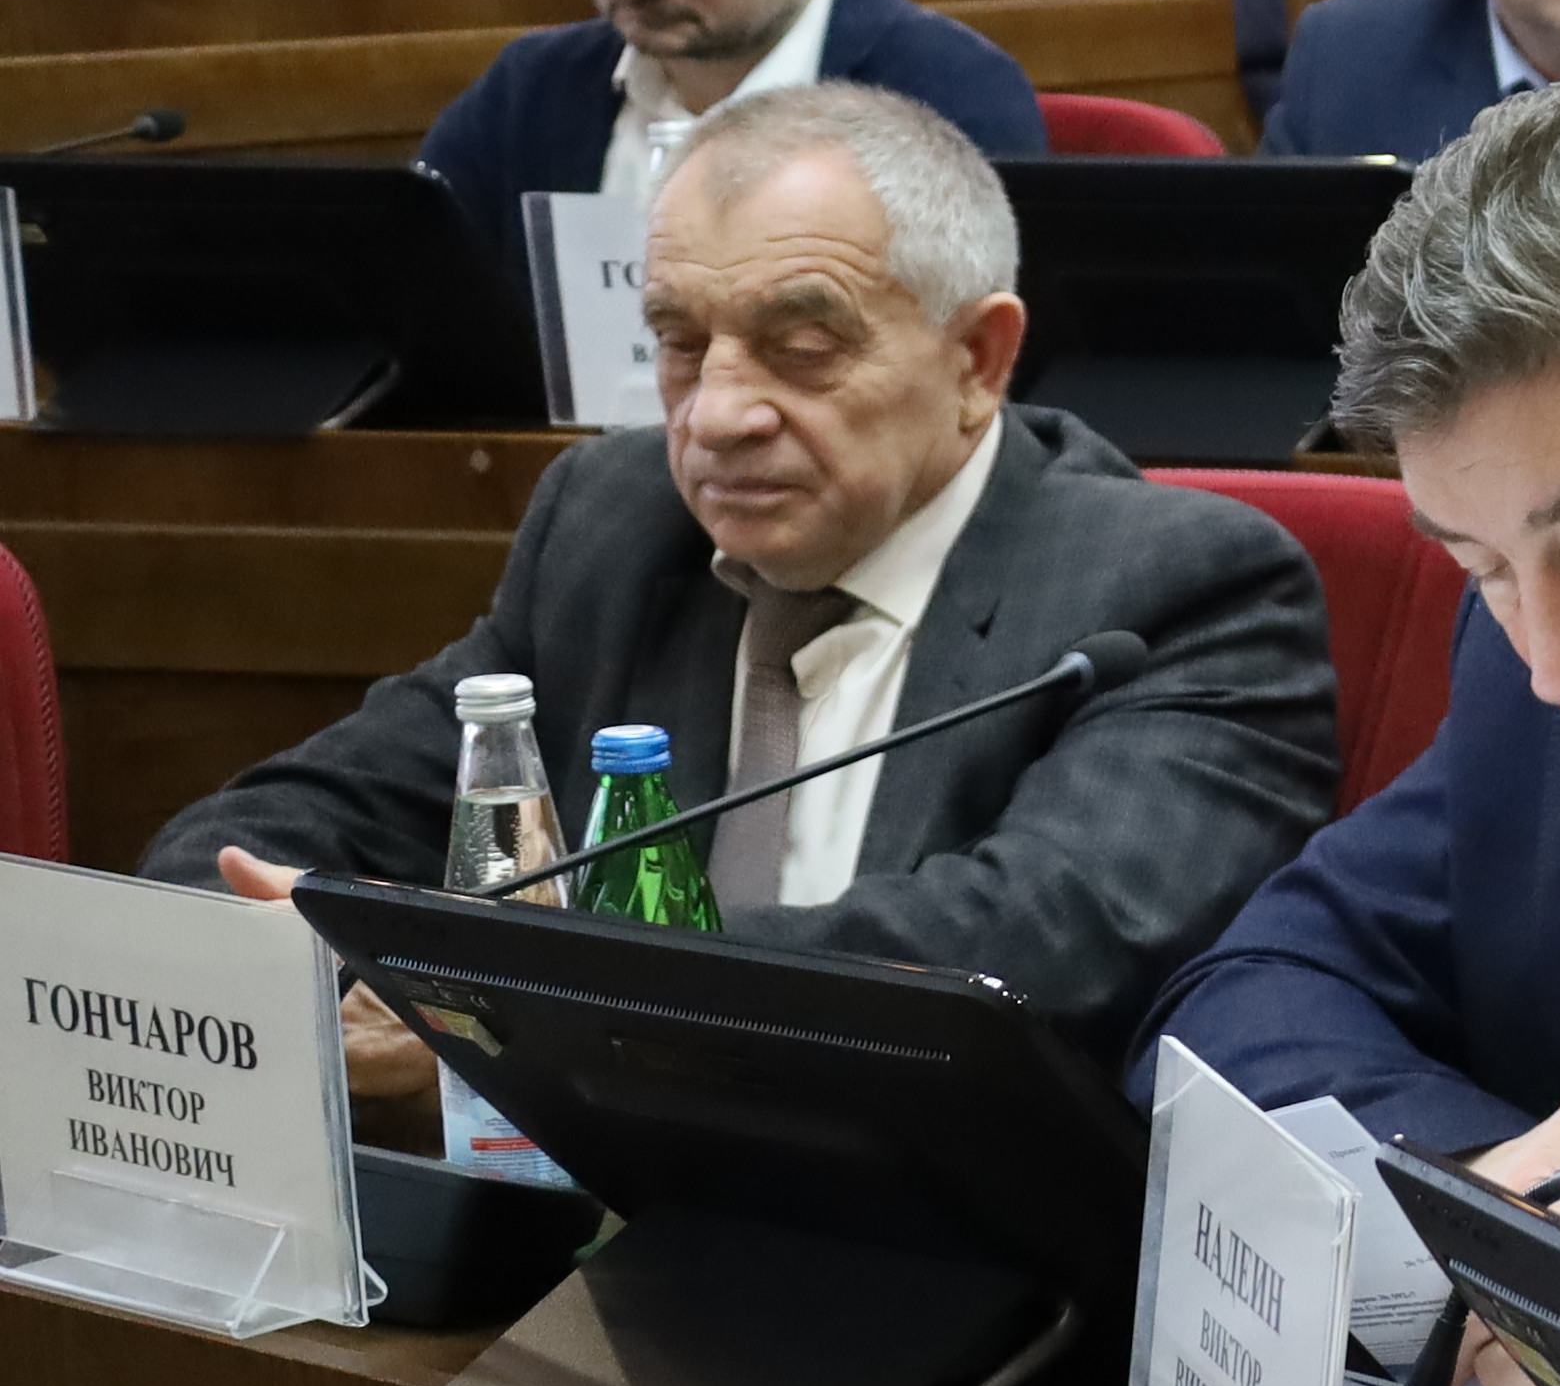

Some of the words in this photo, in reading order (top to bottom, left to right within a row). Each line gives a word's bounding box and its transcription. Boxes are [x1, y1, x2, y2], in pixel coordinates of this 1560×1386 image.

[24, 977, 258, 1070] ГОНЧАРОВ
[86, 1068, 205, 1125] ВИКТОР
[68, 1118, 236, 1187] ИВАНОВИЧ
[1195, 1203, 1285, 1334] НАДЕИН
